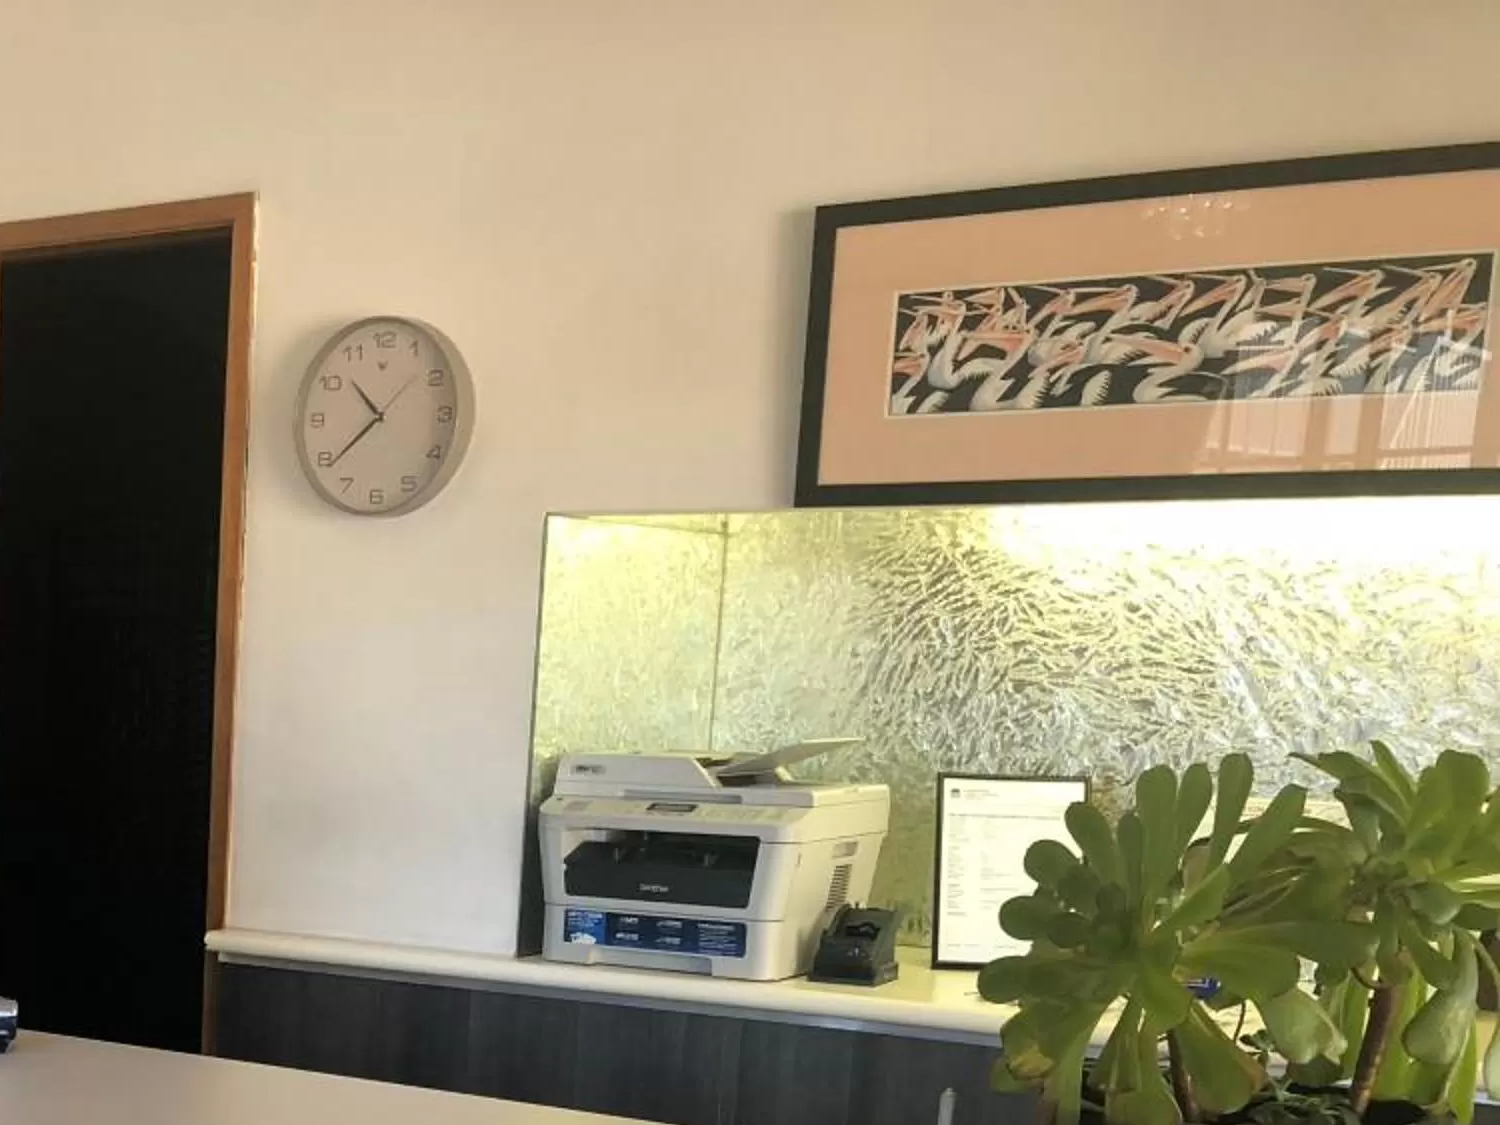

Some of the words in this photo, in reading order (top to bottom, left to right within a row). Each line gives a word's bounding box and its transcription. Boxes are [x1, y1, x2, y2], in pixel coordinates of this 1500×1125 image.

[373, 331, 396, 348] 12
[344, 344, 363, 362] 11
[410, 340, 419, 356] 1
[319, 375, 342, 390] 10
[428, 369, 444, 386] 2
[311, 413, 324, 428] 9
[437, 405, 452, 423] 3
[318, 452, 333, 467] 8
[425, 445, 441, 460] 4
[340, 477, 354, 495] 7
[401, 475, 416, 492] 5
[369, 489, 384, 505] 6
